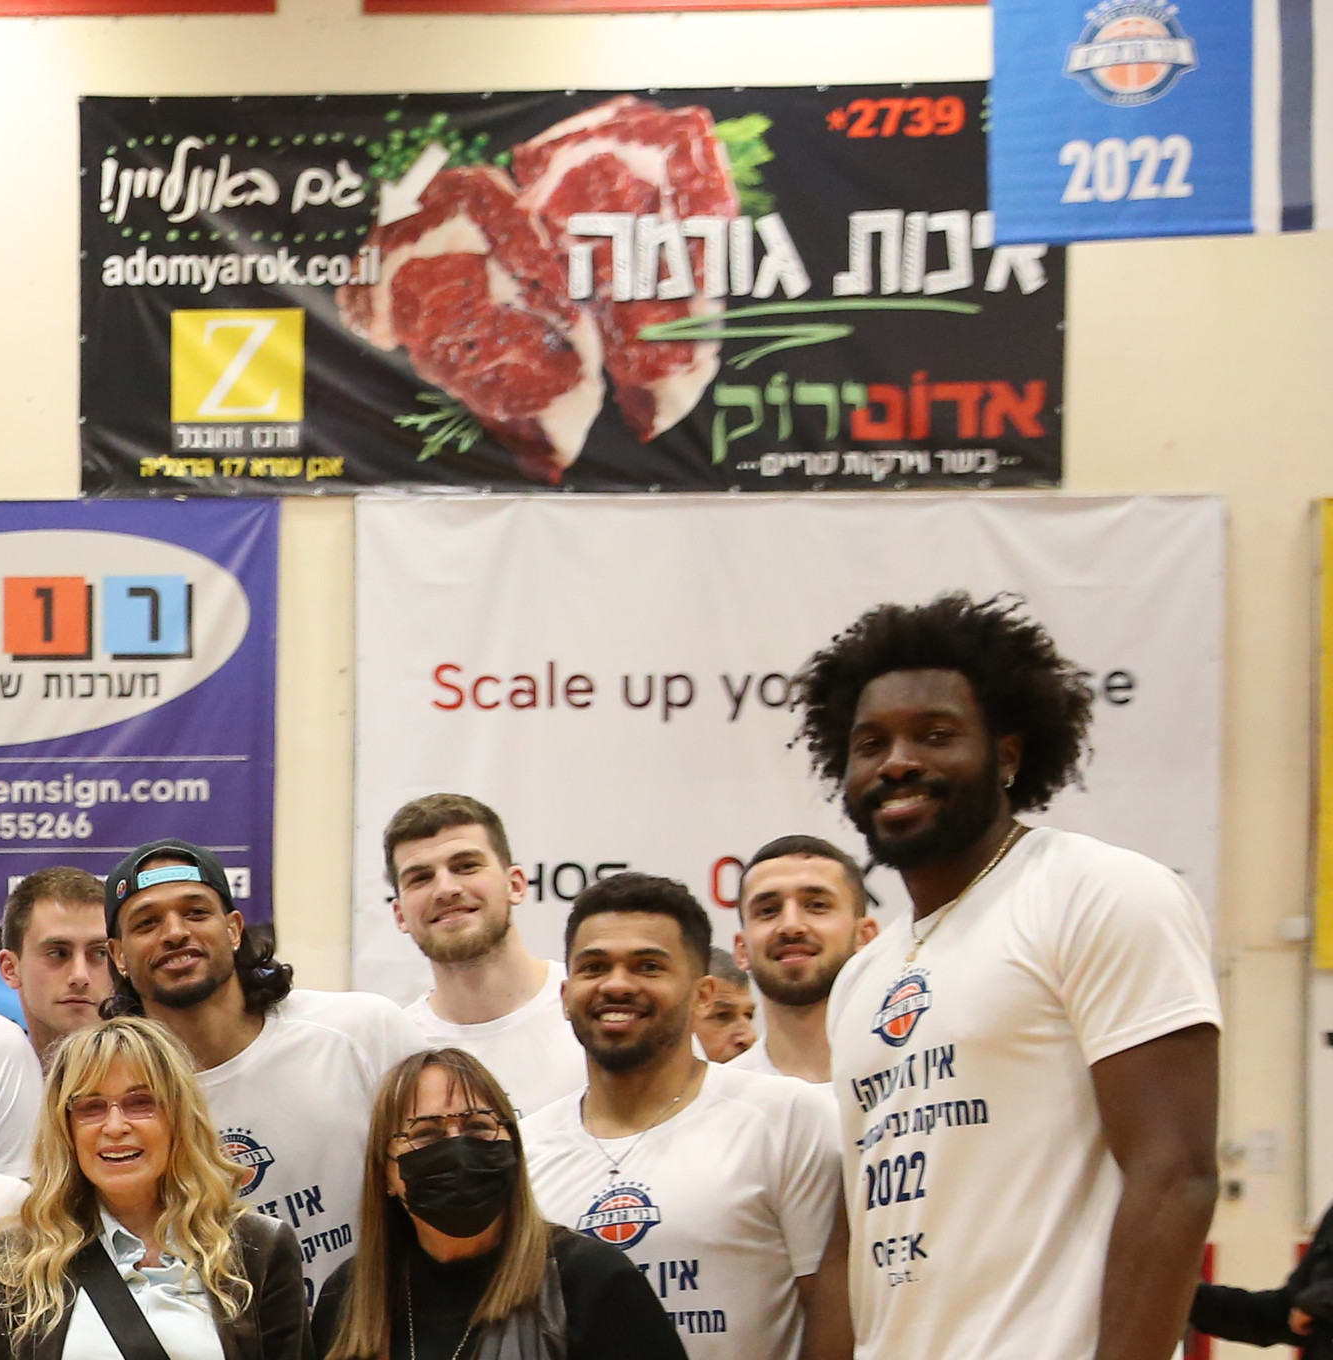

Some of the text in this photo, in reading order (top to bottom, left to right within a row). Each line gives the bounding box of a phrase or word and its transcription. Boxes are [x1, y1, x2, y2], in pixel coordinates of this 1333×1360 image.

[292, 159, 365, 214] גם
[1058, 134, 1194, 204] 2022
[102, 247, 381, 294] adomyarok.co.il
[568, 212, 812, 301] גורמה
[197, 319, 279, 415] Z
[42, 671, 159, 698] מערכות
[432, 661, 788, 721] Scale up yo
[925, 1044, 956, 1089] אין
[245, 1151, 264, 1163] בני
[285, 1185, 325, 1228] אין
[301, 1224, 352, 1263] מחזיק
[659, 1260, 698, 1298] אין
[667, 1310, 727, 1333] מחזי
